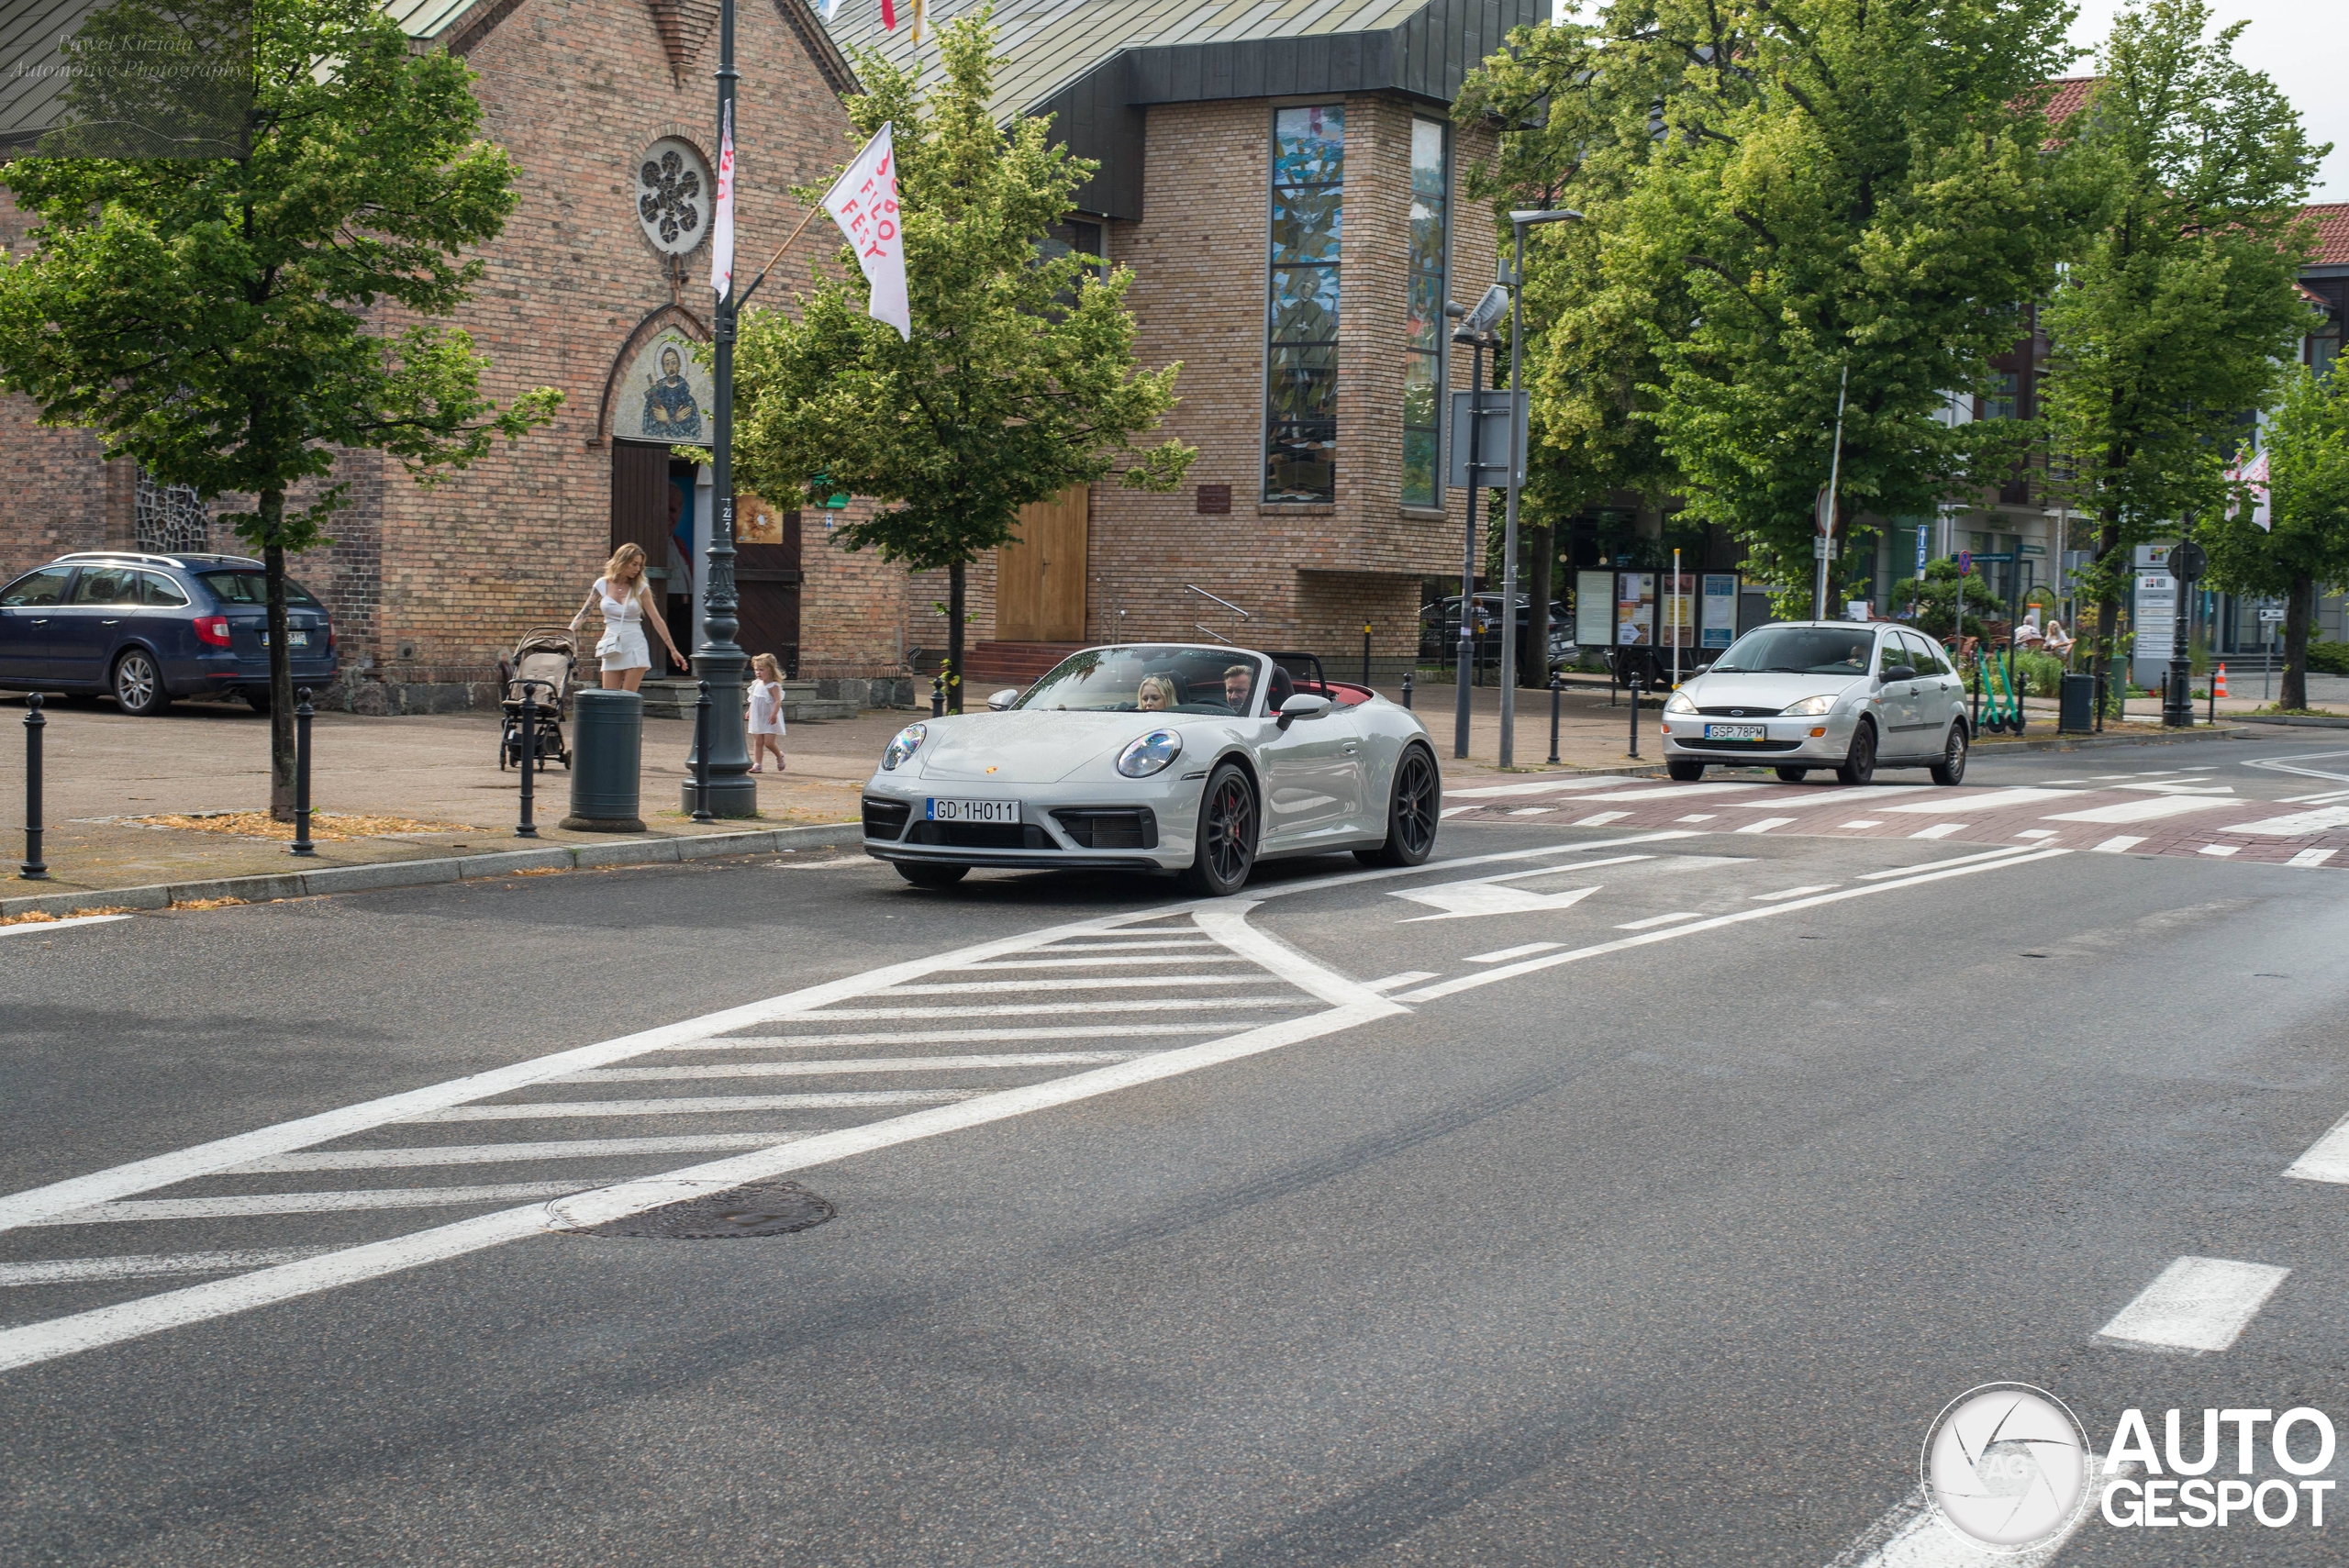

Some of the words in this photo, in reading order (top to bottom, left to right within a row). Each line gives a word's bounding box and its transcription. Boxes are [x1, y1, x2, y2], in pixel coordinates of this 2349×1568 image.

[841, 199, 887, 258] FEST
[1711, 726, 1734, 738] GSP
[1737, 727, 1763, 738] 78PM
[937, 801, 957, 818] GD
[964, 802, 1012, 820] 1H011
